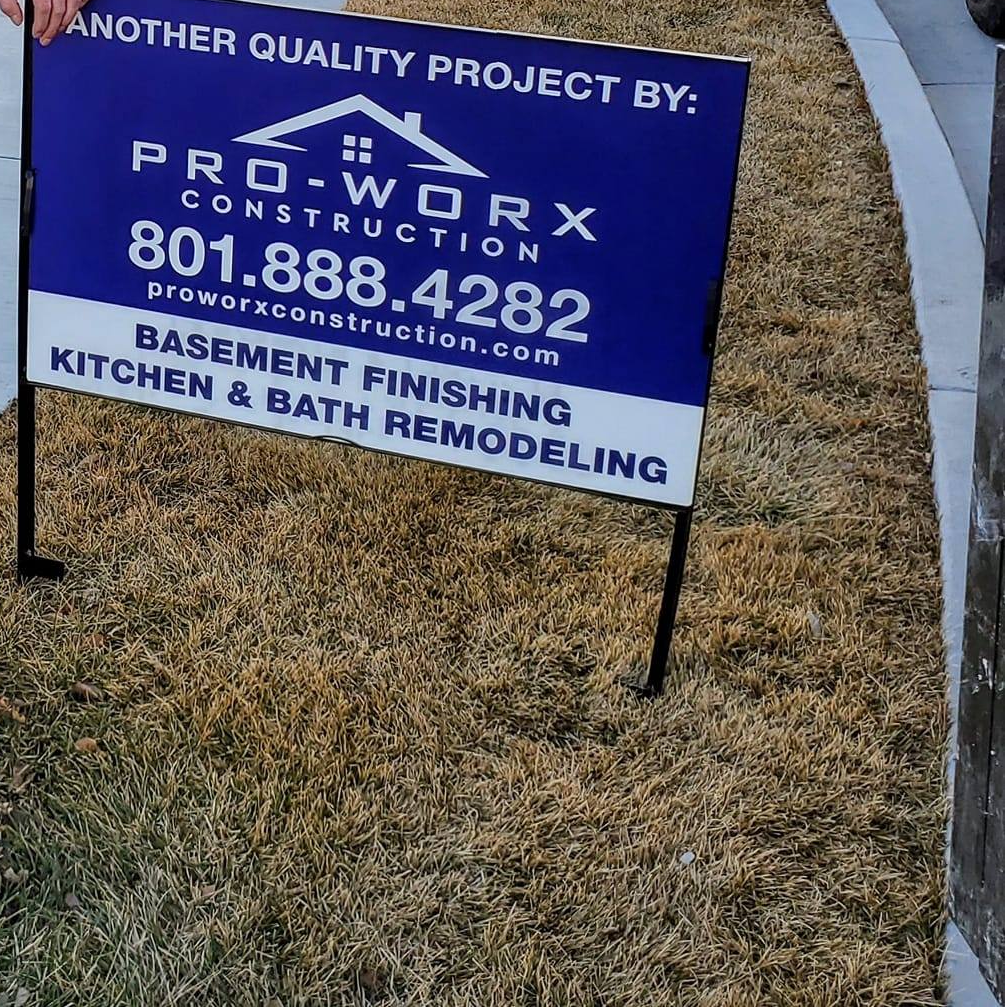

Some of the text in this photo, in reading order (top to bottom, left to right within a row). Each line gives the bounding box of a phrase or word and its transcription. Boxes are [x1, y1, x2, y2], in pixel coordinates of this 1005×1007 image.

[64, 10, 699, 114] ANOTHER QUALITY PROJECT BY:
[131, 140, 598, 242] PRO-WORX
[180, 188, 540, 265] CONSTRUCTION
[128, 220, 592, 343] 801.888.4282
[146, 281, 560, 366] proworxconstruction.com
[50, 346, 668, 485] KITCHEN & BATH REMODELING
[135, 323, 572, 428] BASEMENT FINISHING
